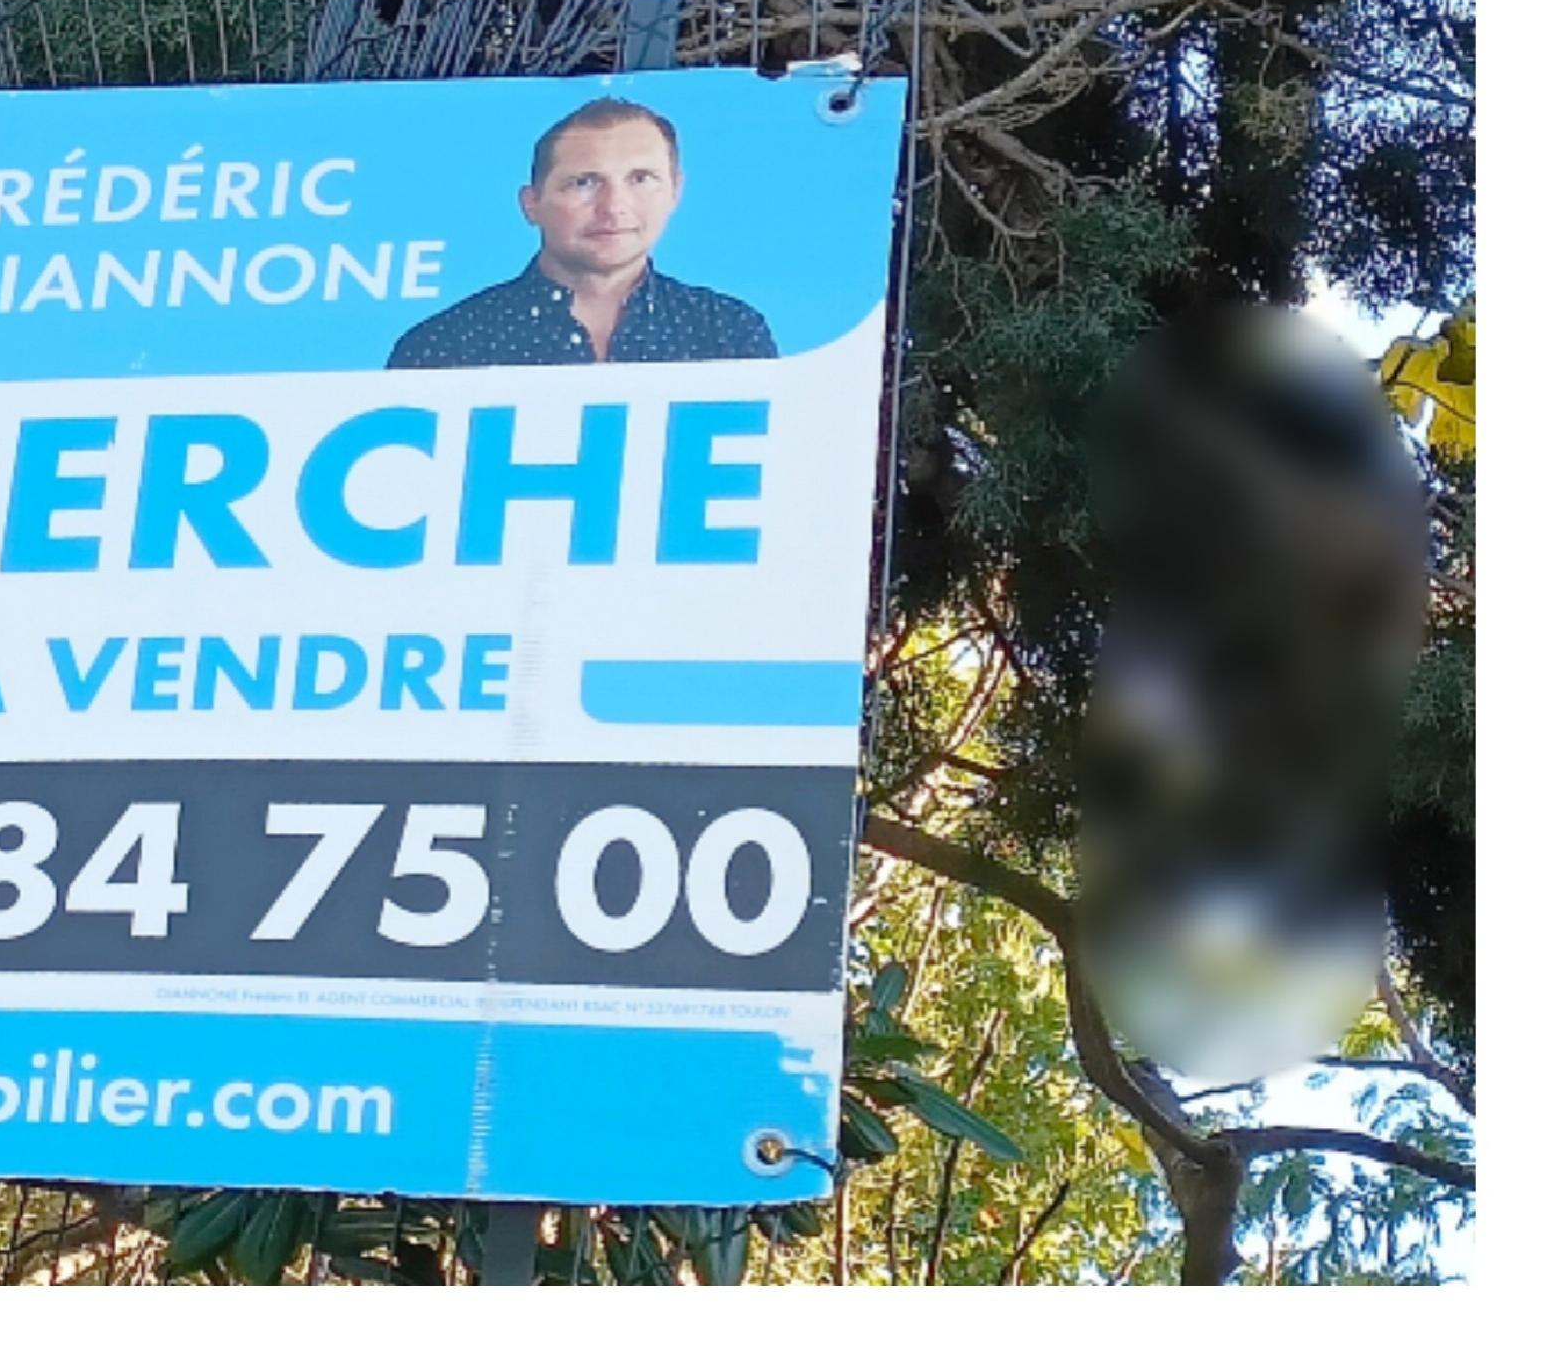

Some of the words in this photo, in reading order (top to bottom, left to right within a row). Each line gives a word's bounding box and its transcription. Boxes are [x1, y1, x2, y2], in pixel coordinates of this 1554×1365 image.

[51, 631, 514, 713] VENDRE
[247, 803, 492, 947] 75
[553, 806, 811, 957] 00
